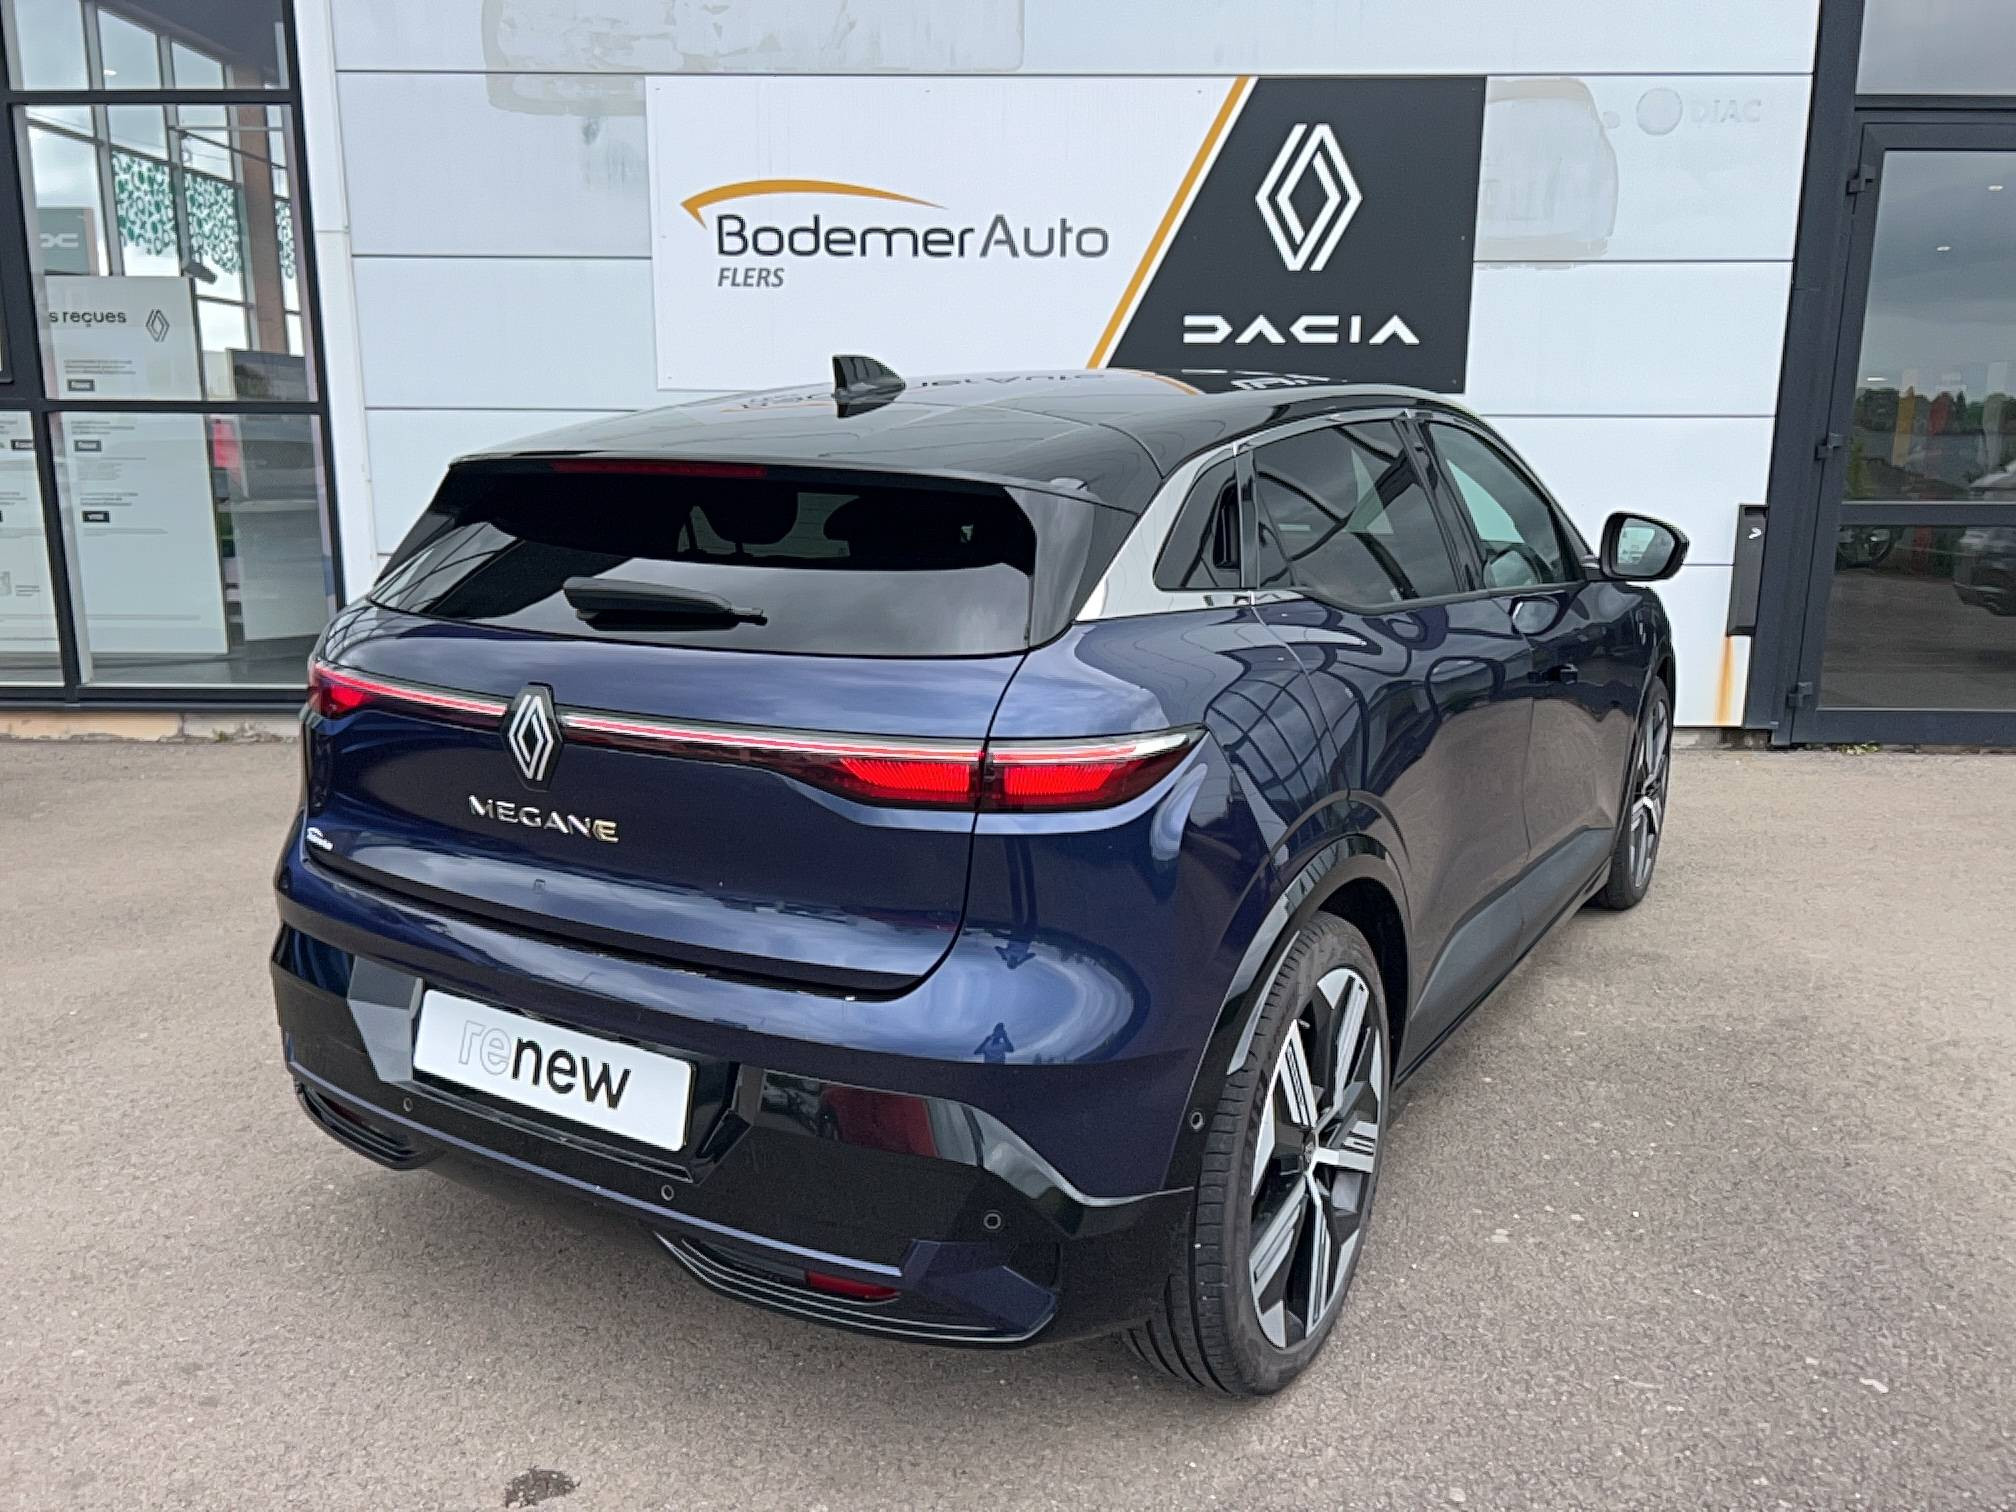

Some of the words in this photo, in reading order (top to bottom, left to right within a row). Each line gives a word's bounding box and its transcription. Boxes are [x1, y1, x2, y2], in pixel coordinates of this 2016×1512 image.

[717, 267, 784, 288] FLERS
[62, 311, 128, 328] reçues
[1183, 314, 1420, 344] DACIA
[468, 794, 620, 844] MEGANE
[458, 1019, 632, 1110] renew
